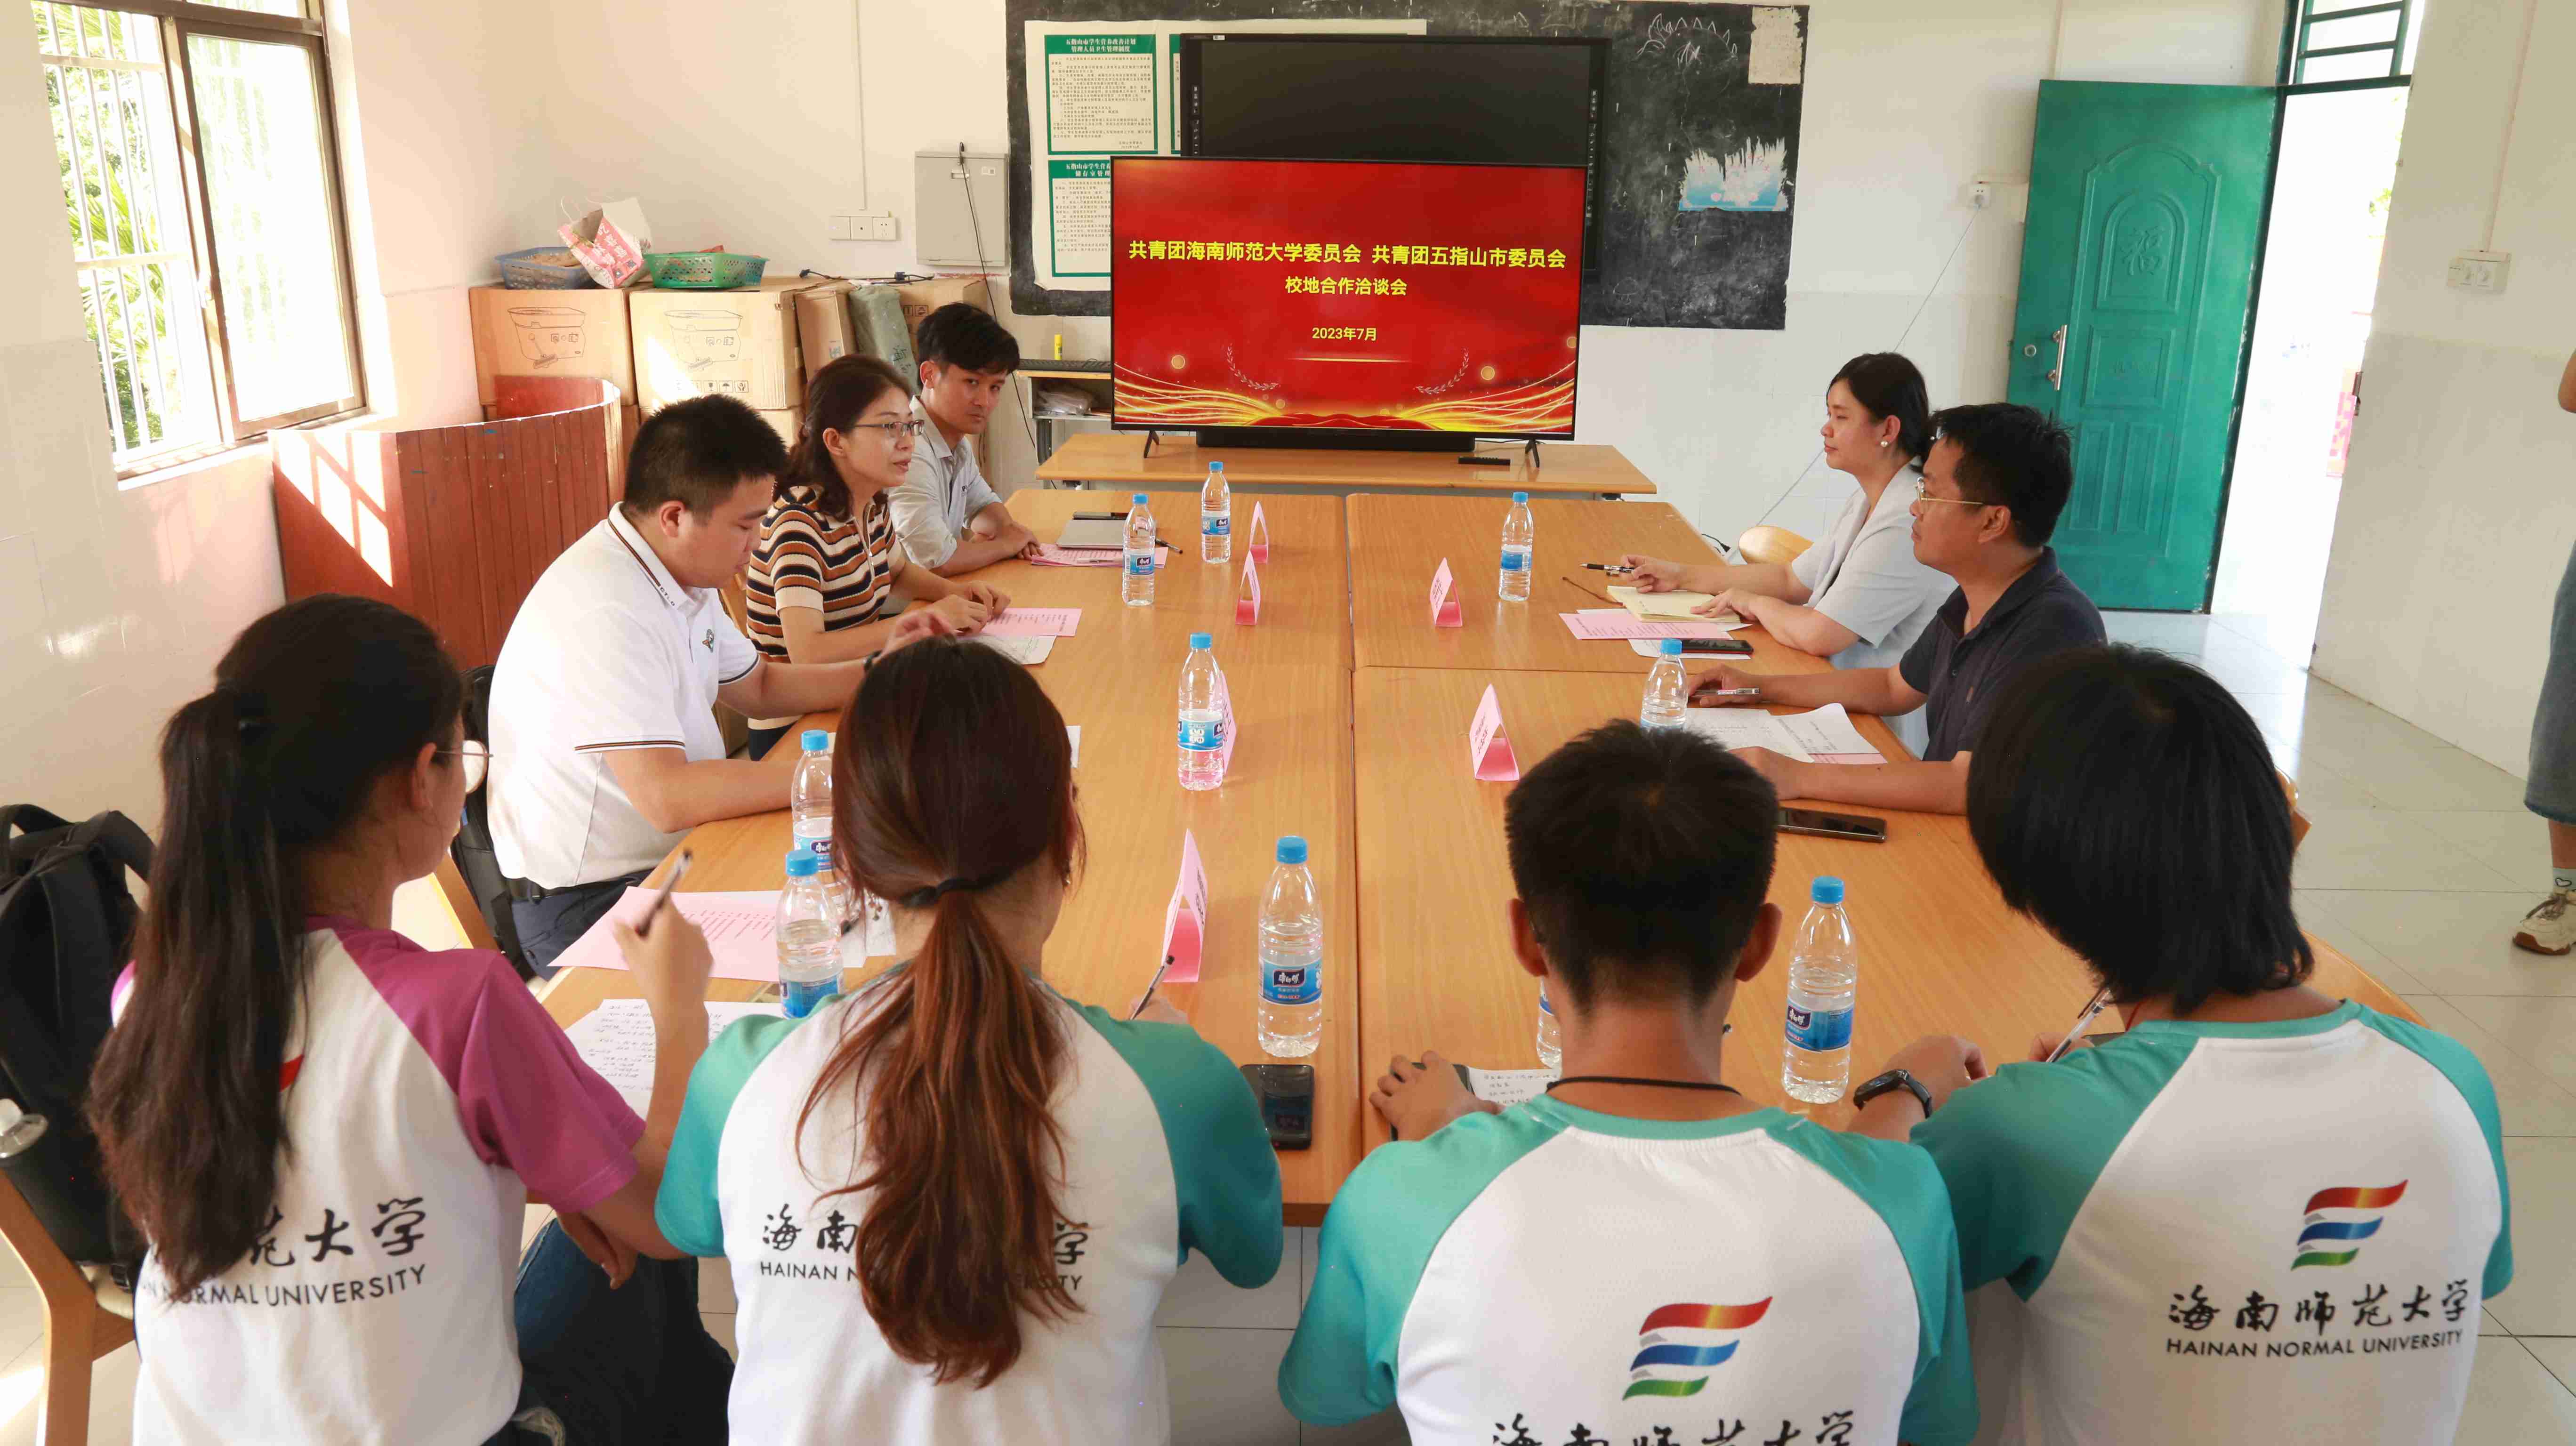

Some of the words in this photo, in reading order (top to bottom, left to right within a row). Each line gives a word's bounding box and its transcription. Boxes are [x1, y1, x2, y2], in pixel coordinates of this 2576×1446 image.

[1129, 240, 1361, 263] 共青团海南师范大学委员会
[1372, 245, 1566, 268] 共青团五指山市委员会
[2121, 225, 2162, 276] 福
[1285, 276, 1407, 296] 校地合作洽谈会
[1312, 327, 1377, 342] 2023年7月
[760, 1261, 838, 1280] HAINAN
[265, 1264, 426, 1306] UNIVERSITY
[2169, 1279, 2467, 1335] 海南师范大学
[2166, 1338, 2257, 1357] HAINAN
[2266, 1339, 2354, 1358] NORMAL
[2363, 1329, 2462, 1353] UNIVERSITY
